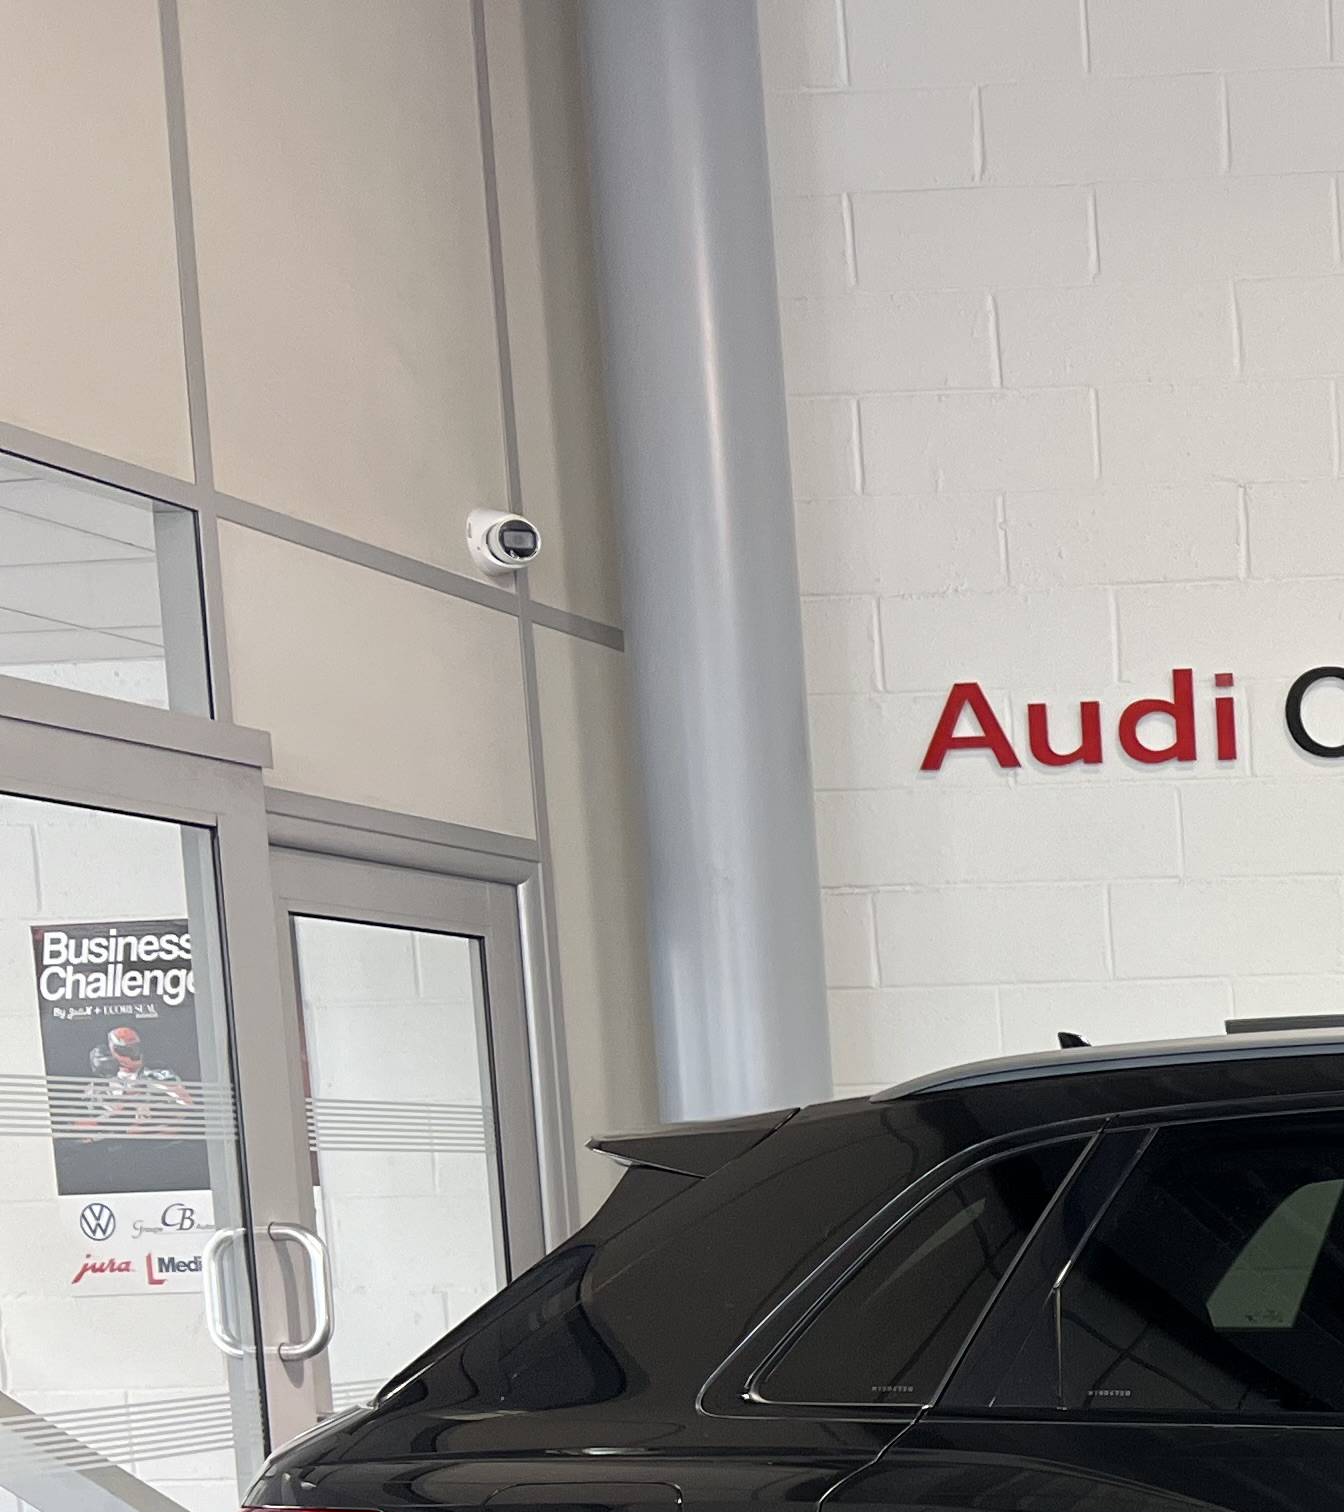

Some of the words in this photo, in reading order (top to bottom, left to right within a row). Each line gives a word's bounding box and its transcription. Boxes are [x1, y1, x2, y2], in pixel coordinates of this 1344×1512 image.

[920, 668, 1238, 772] Audi
[43, 929, 192, 966] Business
[71, 1253, 132, 1285] jura
